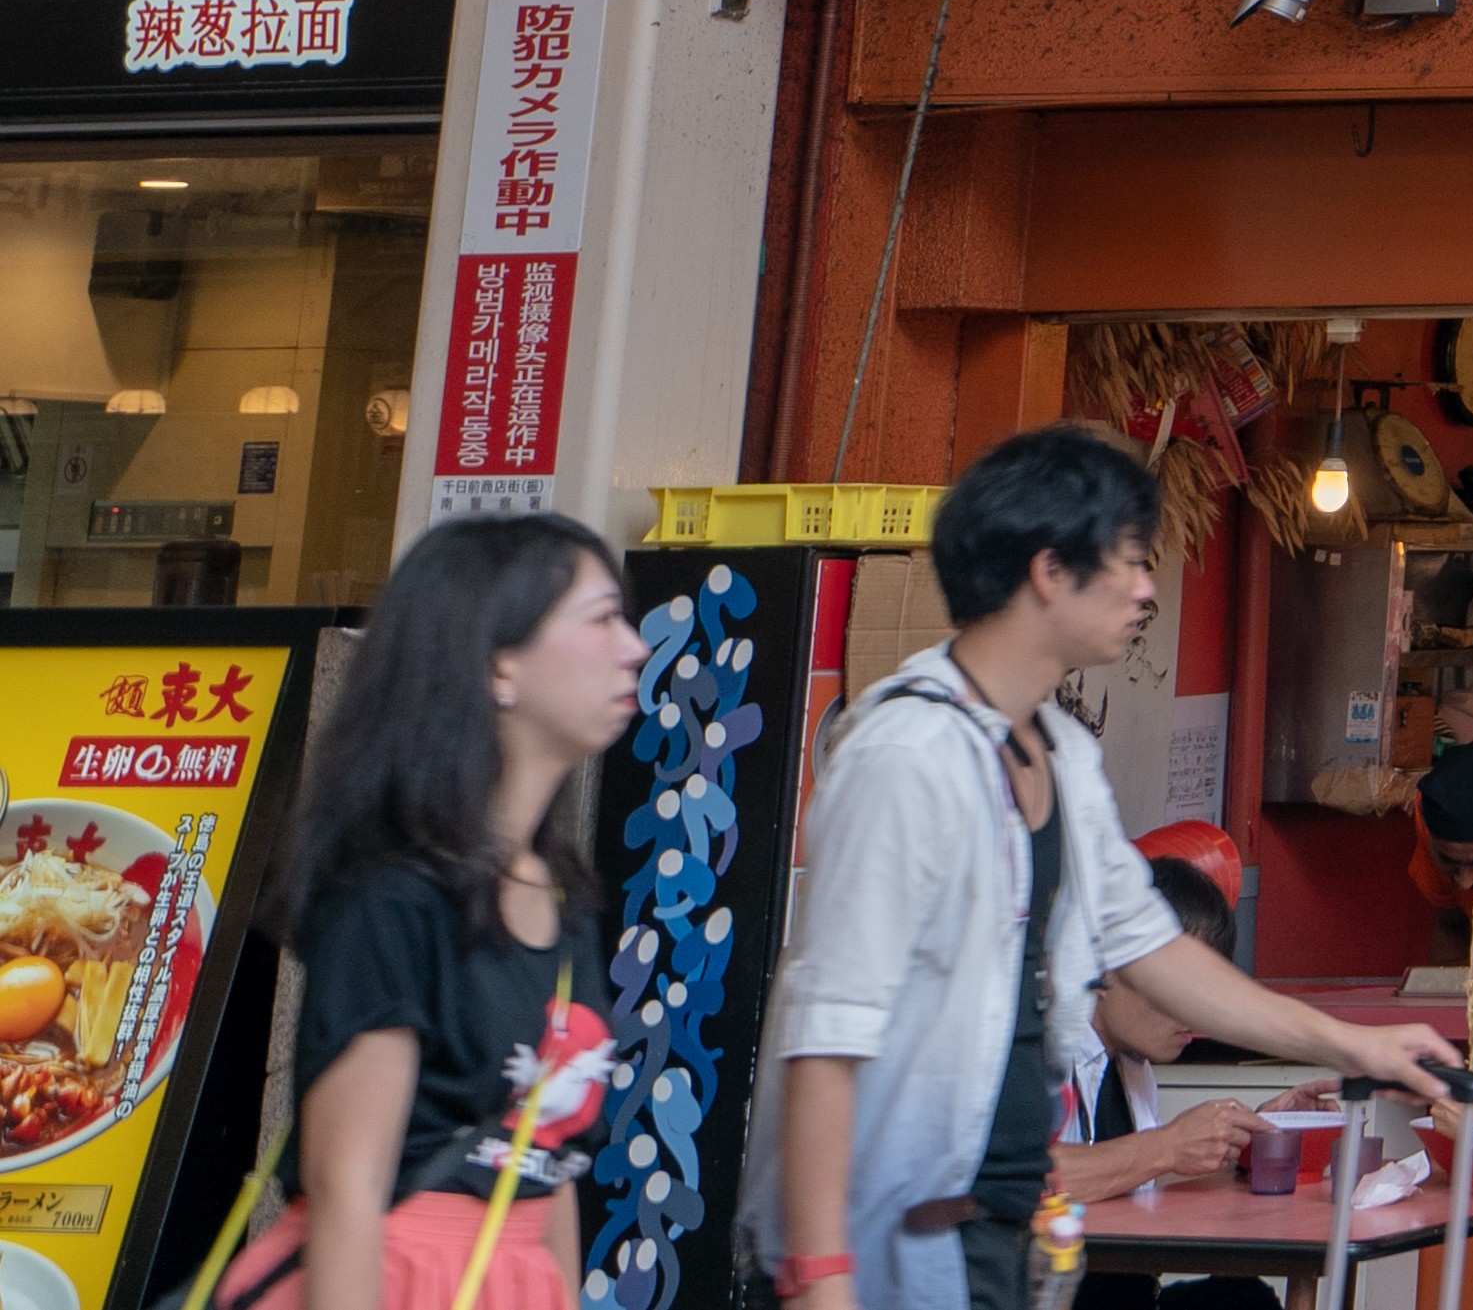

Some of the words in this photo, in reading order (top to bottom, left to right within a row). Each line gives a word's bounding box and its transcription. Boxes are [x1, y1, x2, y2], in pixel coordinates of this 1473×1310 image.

[494, 3, 575, 237] 防犯カメラ作動中
[455, 261, 510, 468] 방범카메라작동중
[504, 261, 557, 467] 监视摄像头正在运作中
